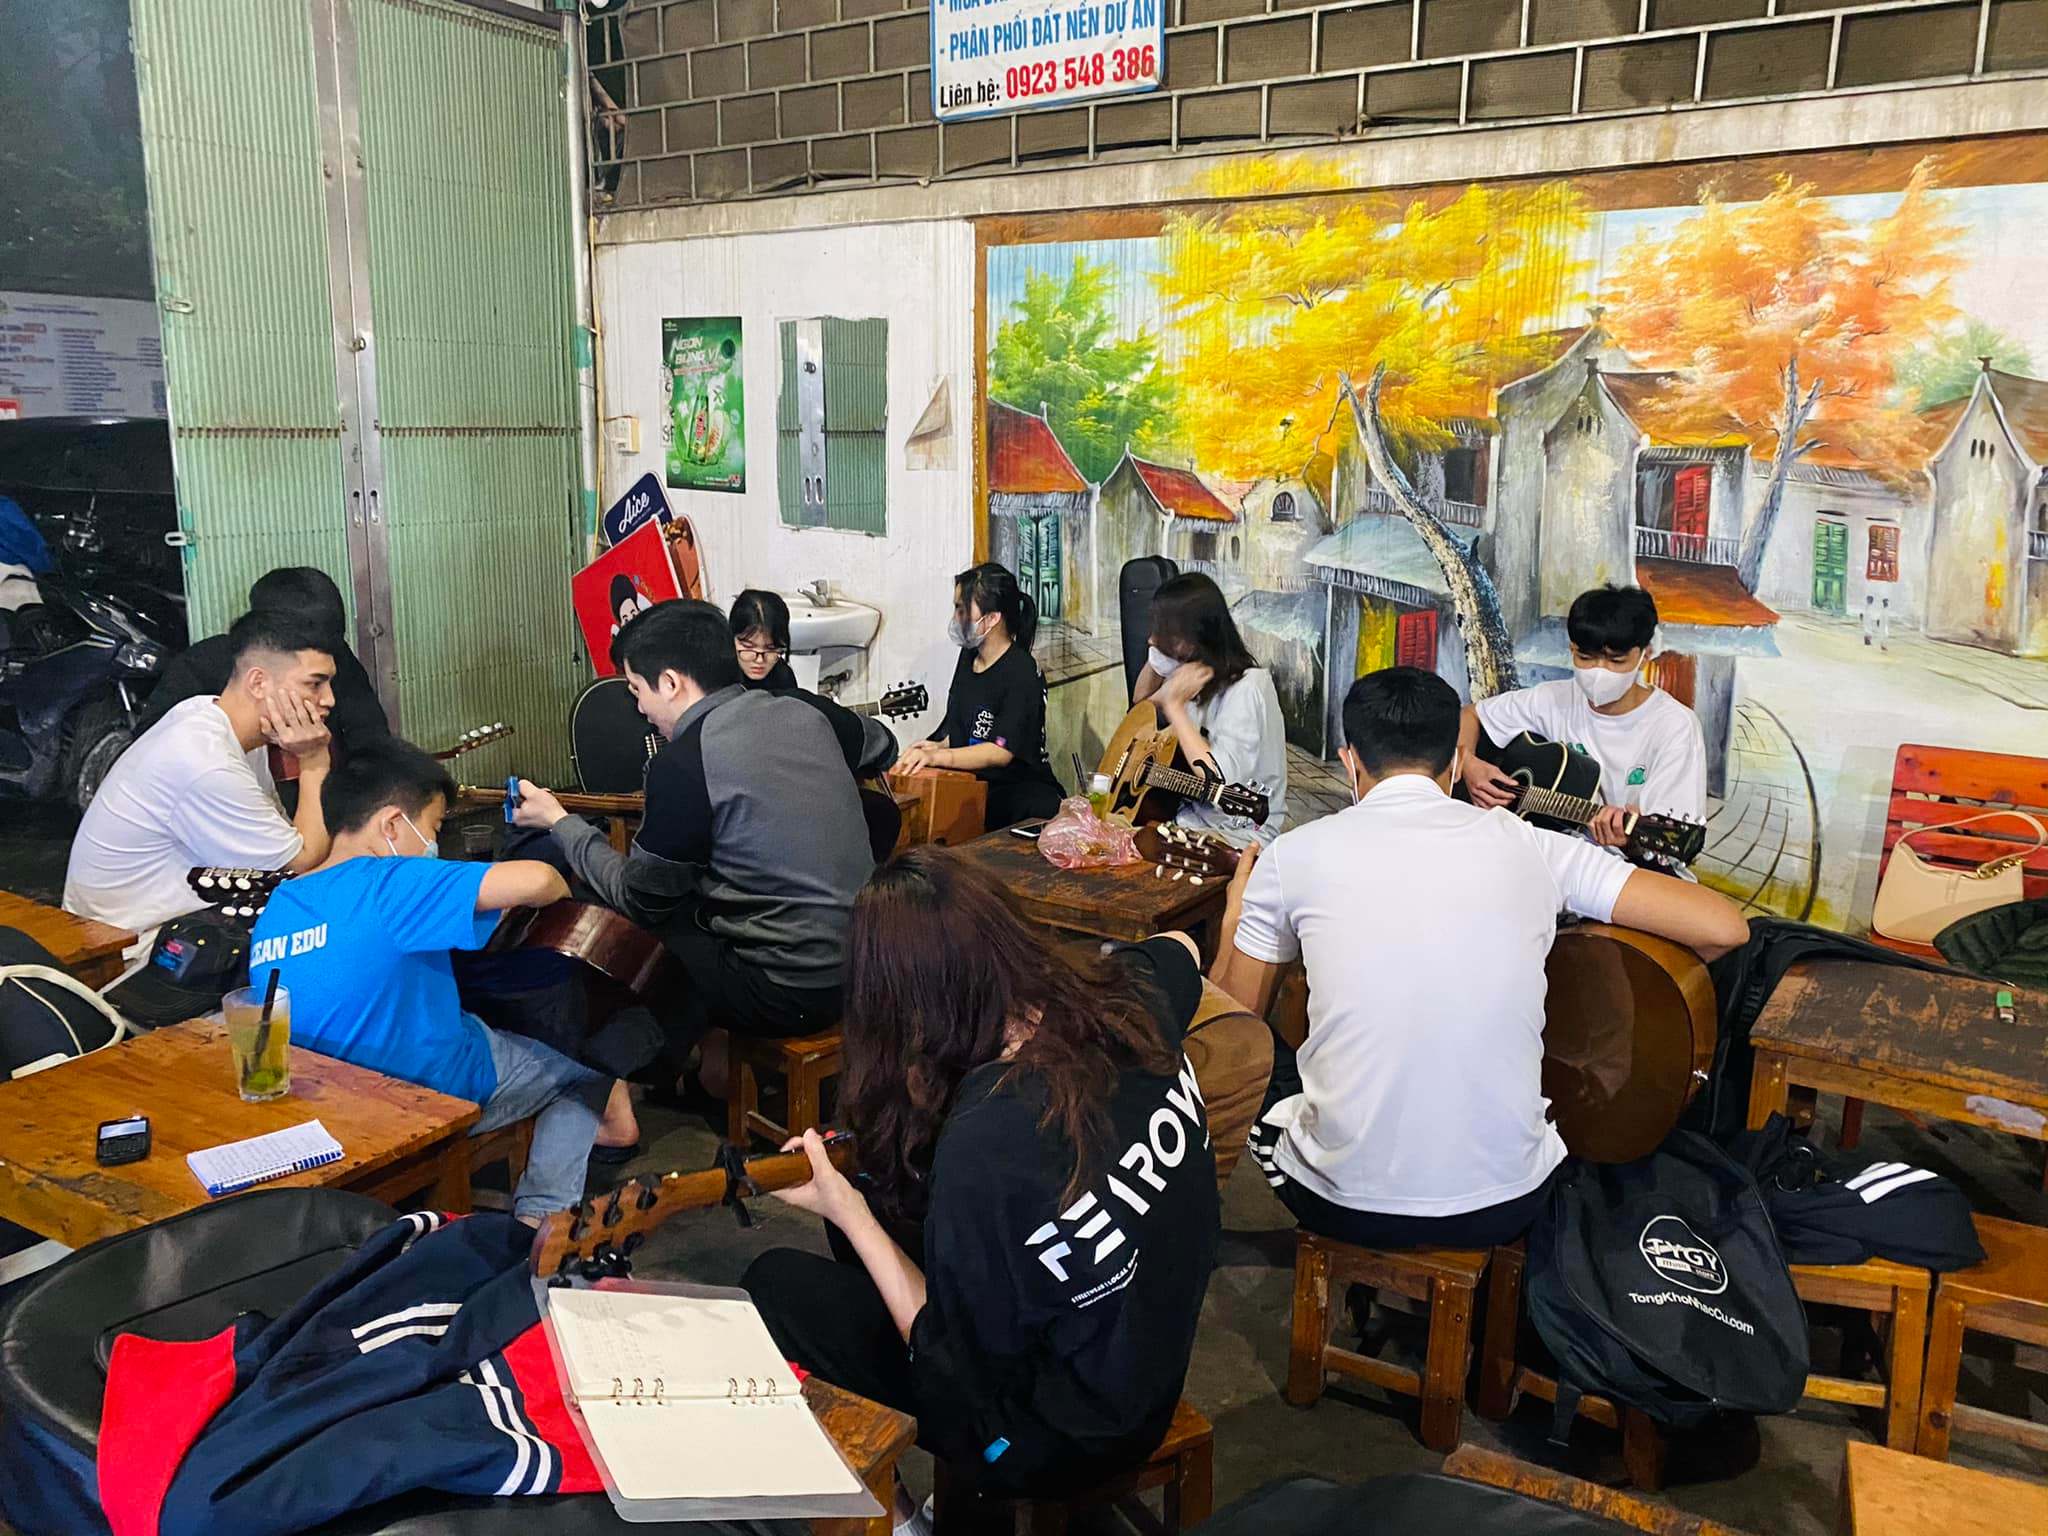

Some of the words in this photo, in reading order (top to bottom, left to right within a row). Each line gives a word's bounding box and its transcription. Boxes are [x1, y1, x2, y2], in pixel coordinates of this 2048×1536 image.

[950, 24, 989, 62] PHÂN
[994, 9, 1027, 55] PHỐI
[1032, 4, 1061, 47] ĐẤT
[1105, 0, 1128, 39] DỰ
[940, 83, 972, 108] Liên
[977, 78, 1000, 107] hệ:
[1006, 60, 1057, 99] 0923
[1064, 53, 1105, 90] 548
[1112, 44, 1155, 82] 386
[618, 492, 650, 533] Aice
[290, 922, 328, 956] EDU
[1628, 1292, 1754, 1336] TongKhoNhacCu.com
